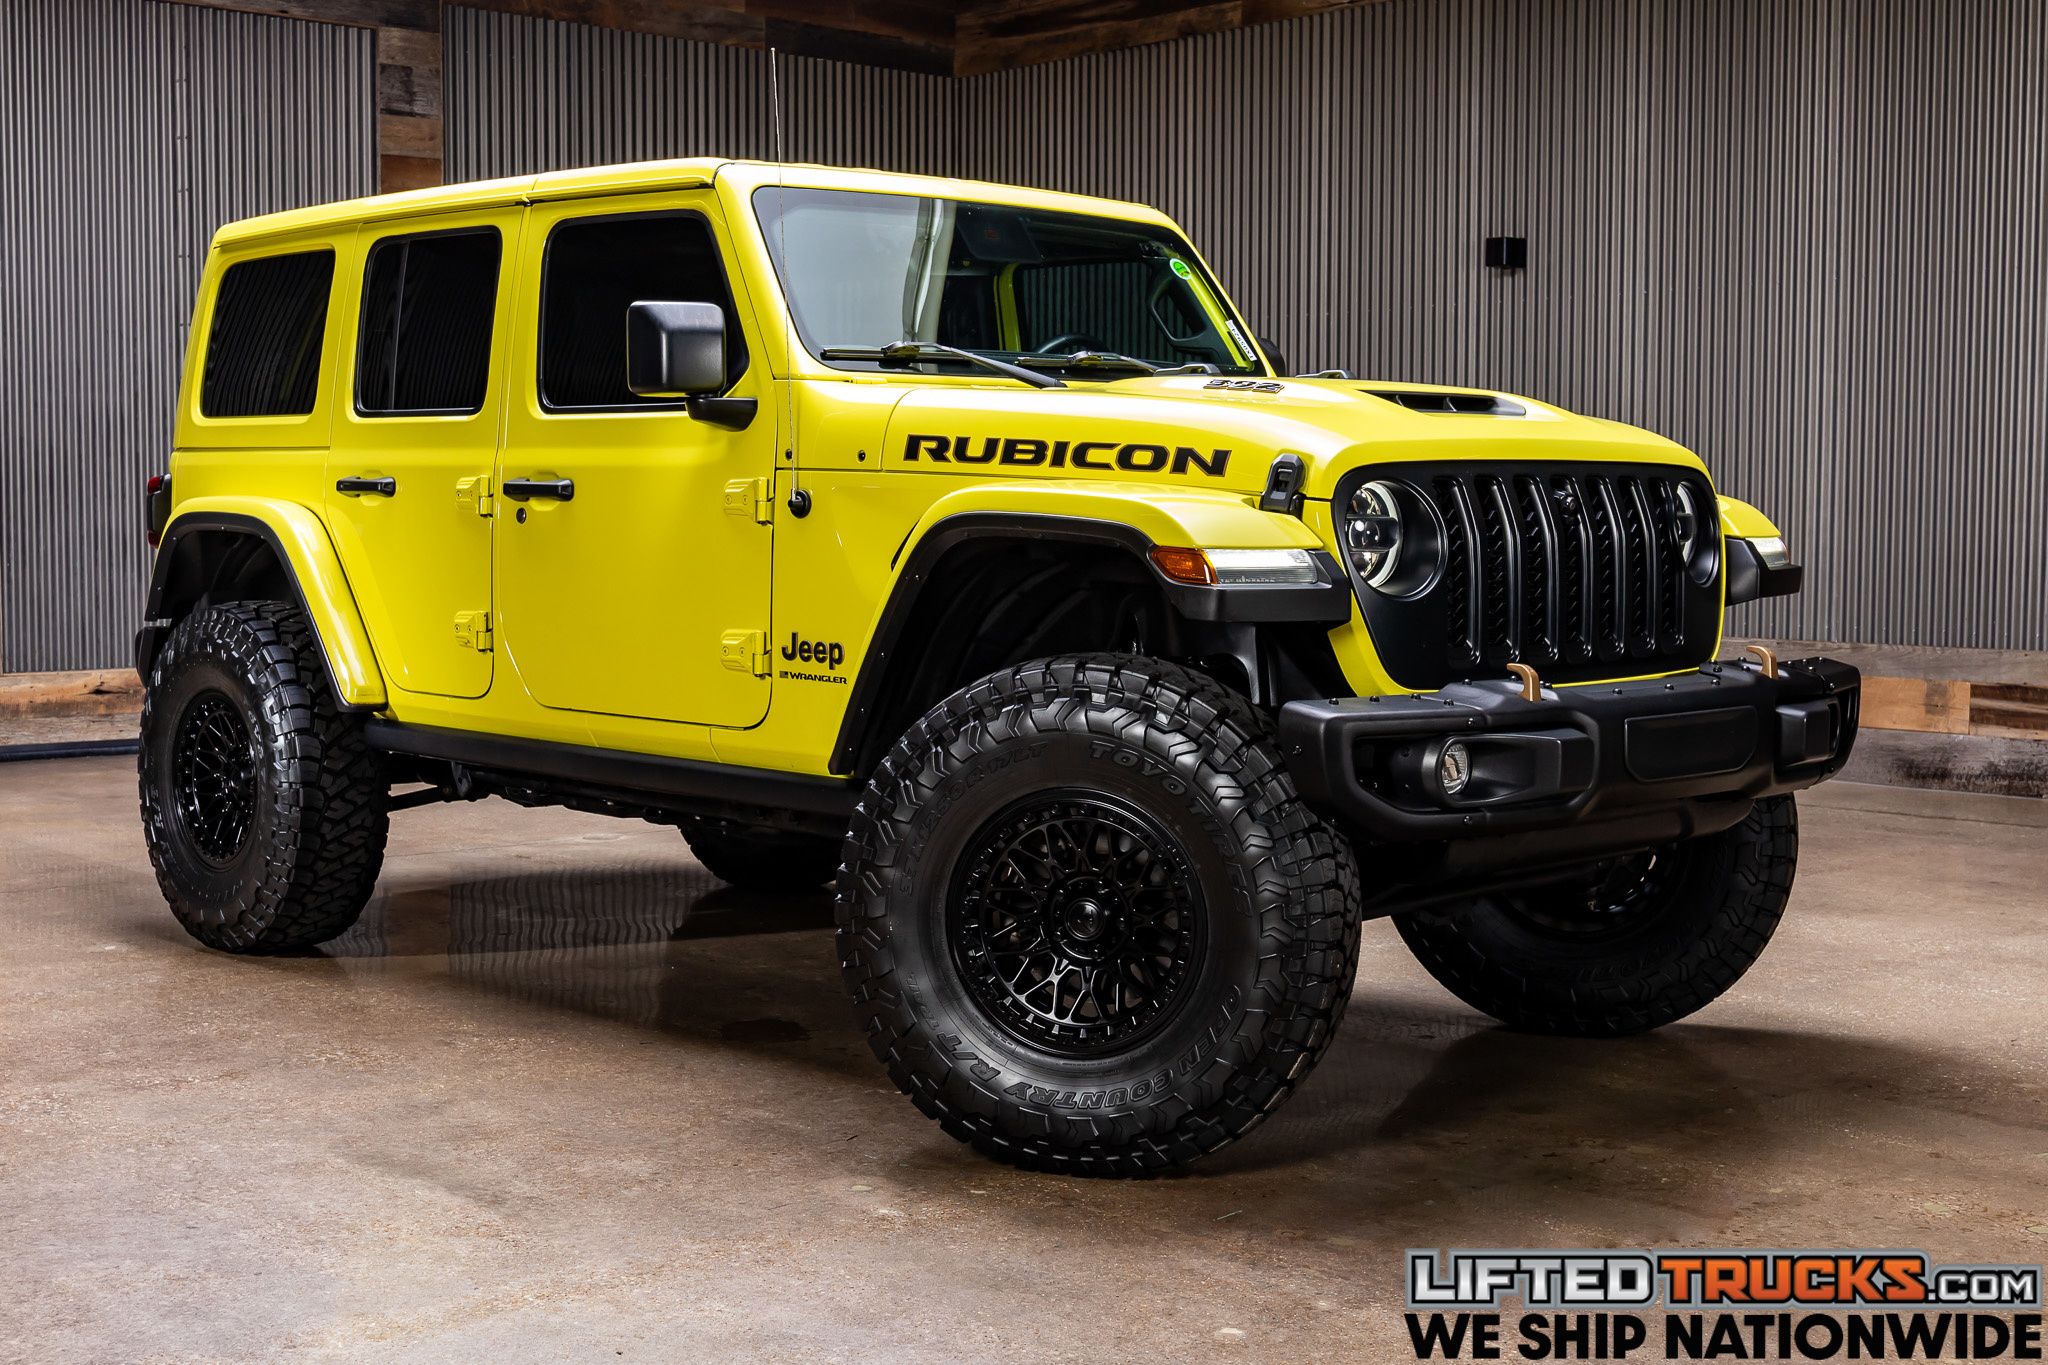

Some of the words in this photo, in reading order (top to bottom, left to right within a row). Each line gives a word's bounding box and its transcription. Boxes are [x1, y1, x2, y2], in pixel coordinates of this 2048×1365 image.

[1203, 379, 1285, 394] 392
[903, 434, 1233, 477] RUBICON
[781, 631, 845, 670] Jeep
[789, 671, 848, 685] WRANGLER
[1090, 740, 1188, 796] TOYO
[1178, 984, 1240, 1076] OPEN
[936, 1030, 1002, 1083] R/T
[1004, 1068, 1174, 1110] COUNTRY
